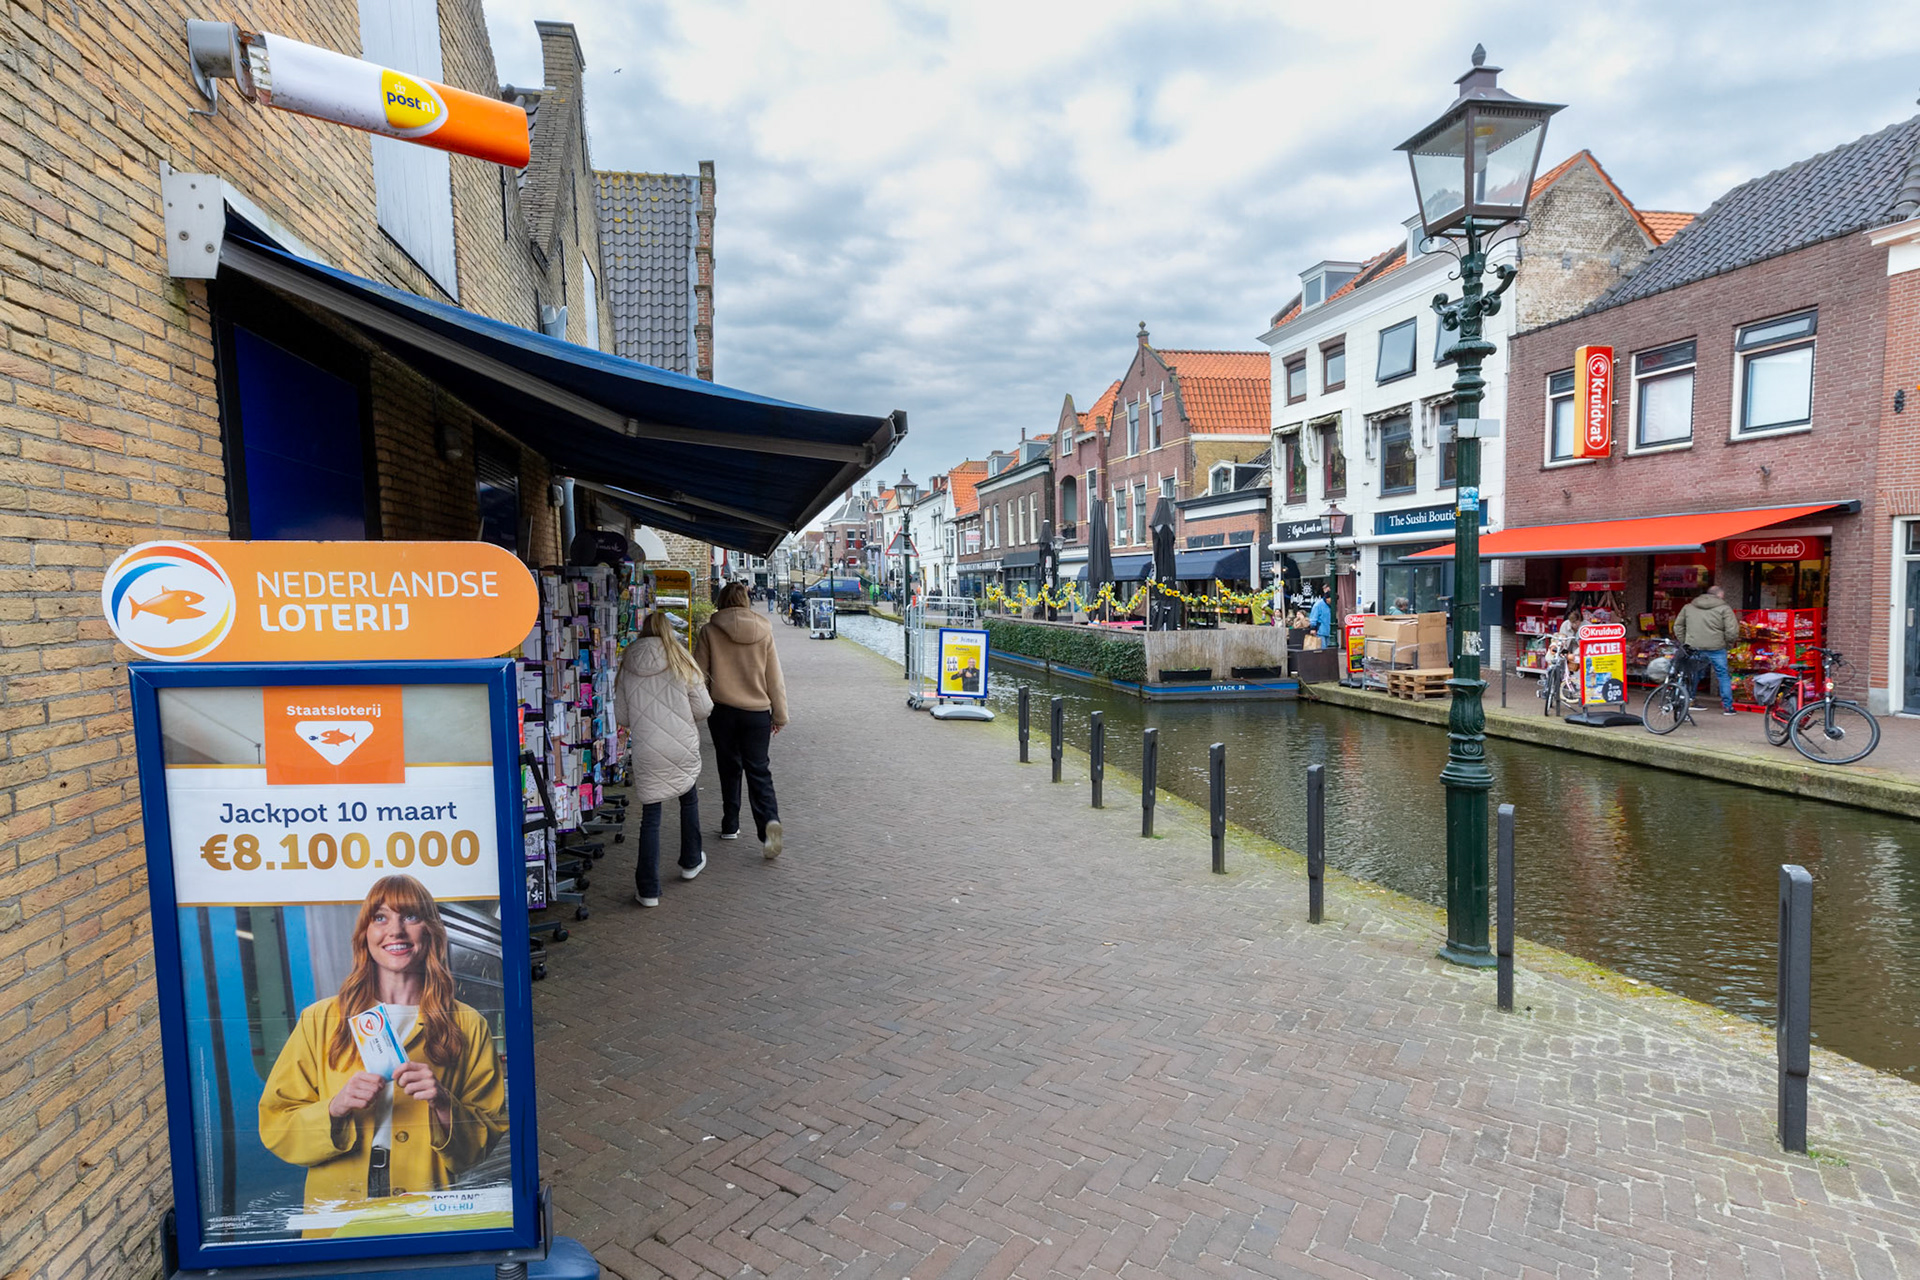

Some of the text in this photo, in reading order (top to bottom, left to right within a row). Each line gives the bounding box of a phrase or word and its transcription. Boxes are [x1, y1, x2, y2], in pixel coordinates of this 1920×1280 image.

[1590, 378, 1606, 443] Kruidvat
[1389, 514, 1406, 527] The
[1406, 512, 1427, 524] Sushi
[1751, 543, 1799, 556] Kruidvat
[257, 571, 499, 598] NEDERLANDSE
[260, 603, 410, 632] LOTERIJ
[1590, 627, 1622, 636] Kruidvat
[1586, 642, 1620, 655] ACTIE!
[286, 704, 382, 718] Staatsloterij
[219, 802, 458, 828] Jackpot 10 maart
[200, 829, 481, 871] €8.100.000
